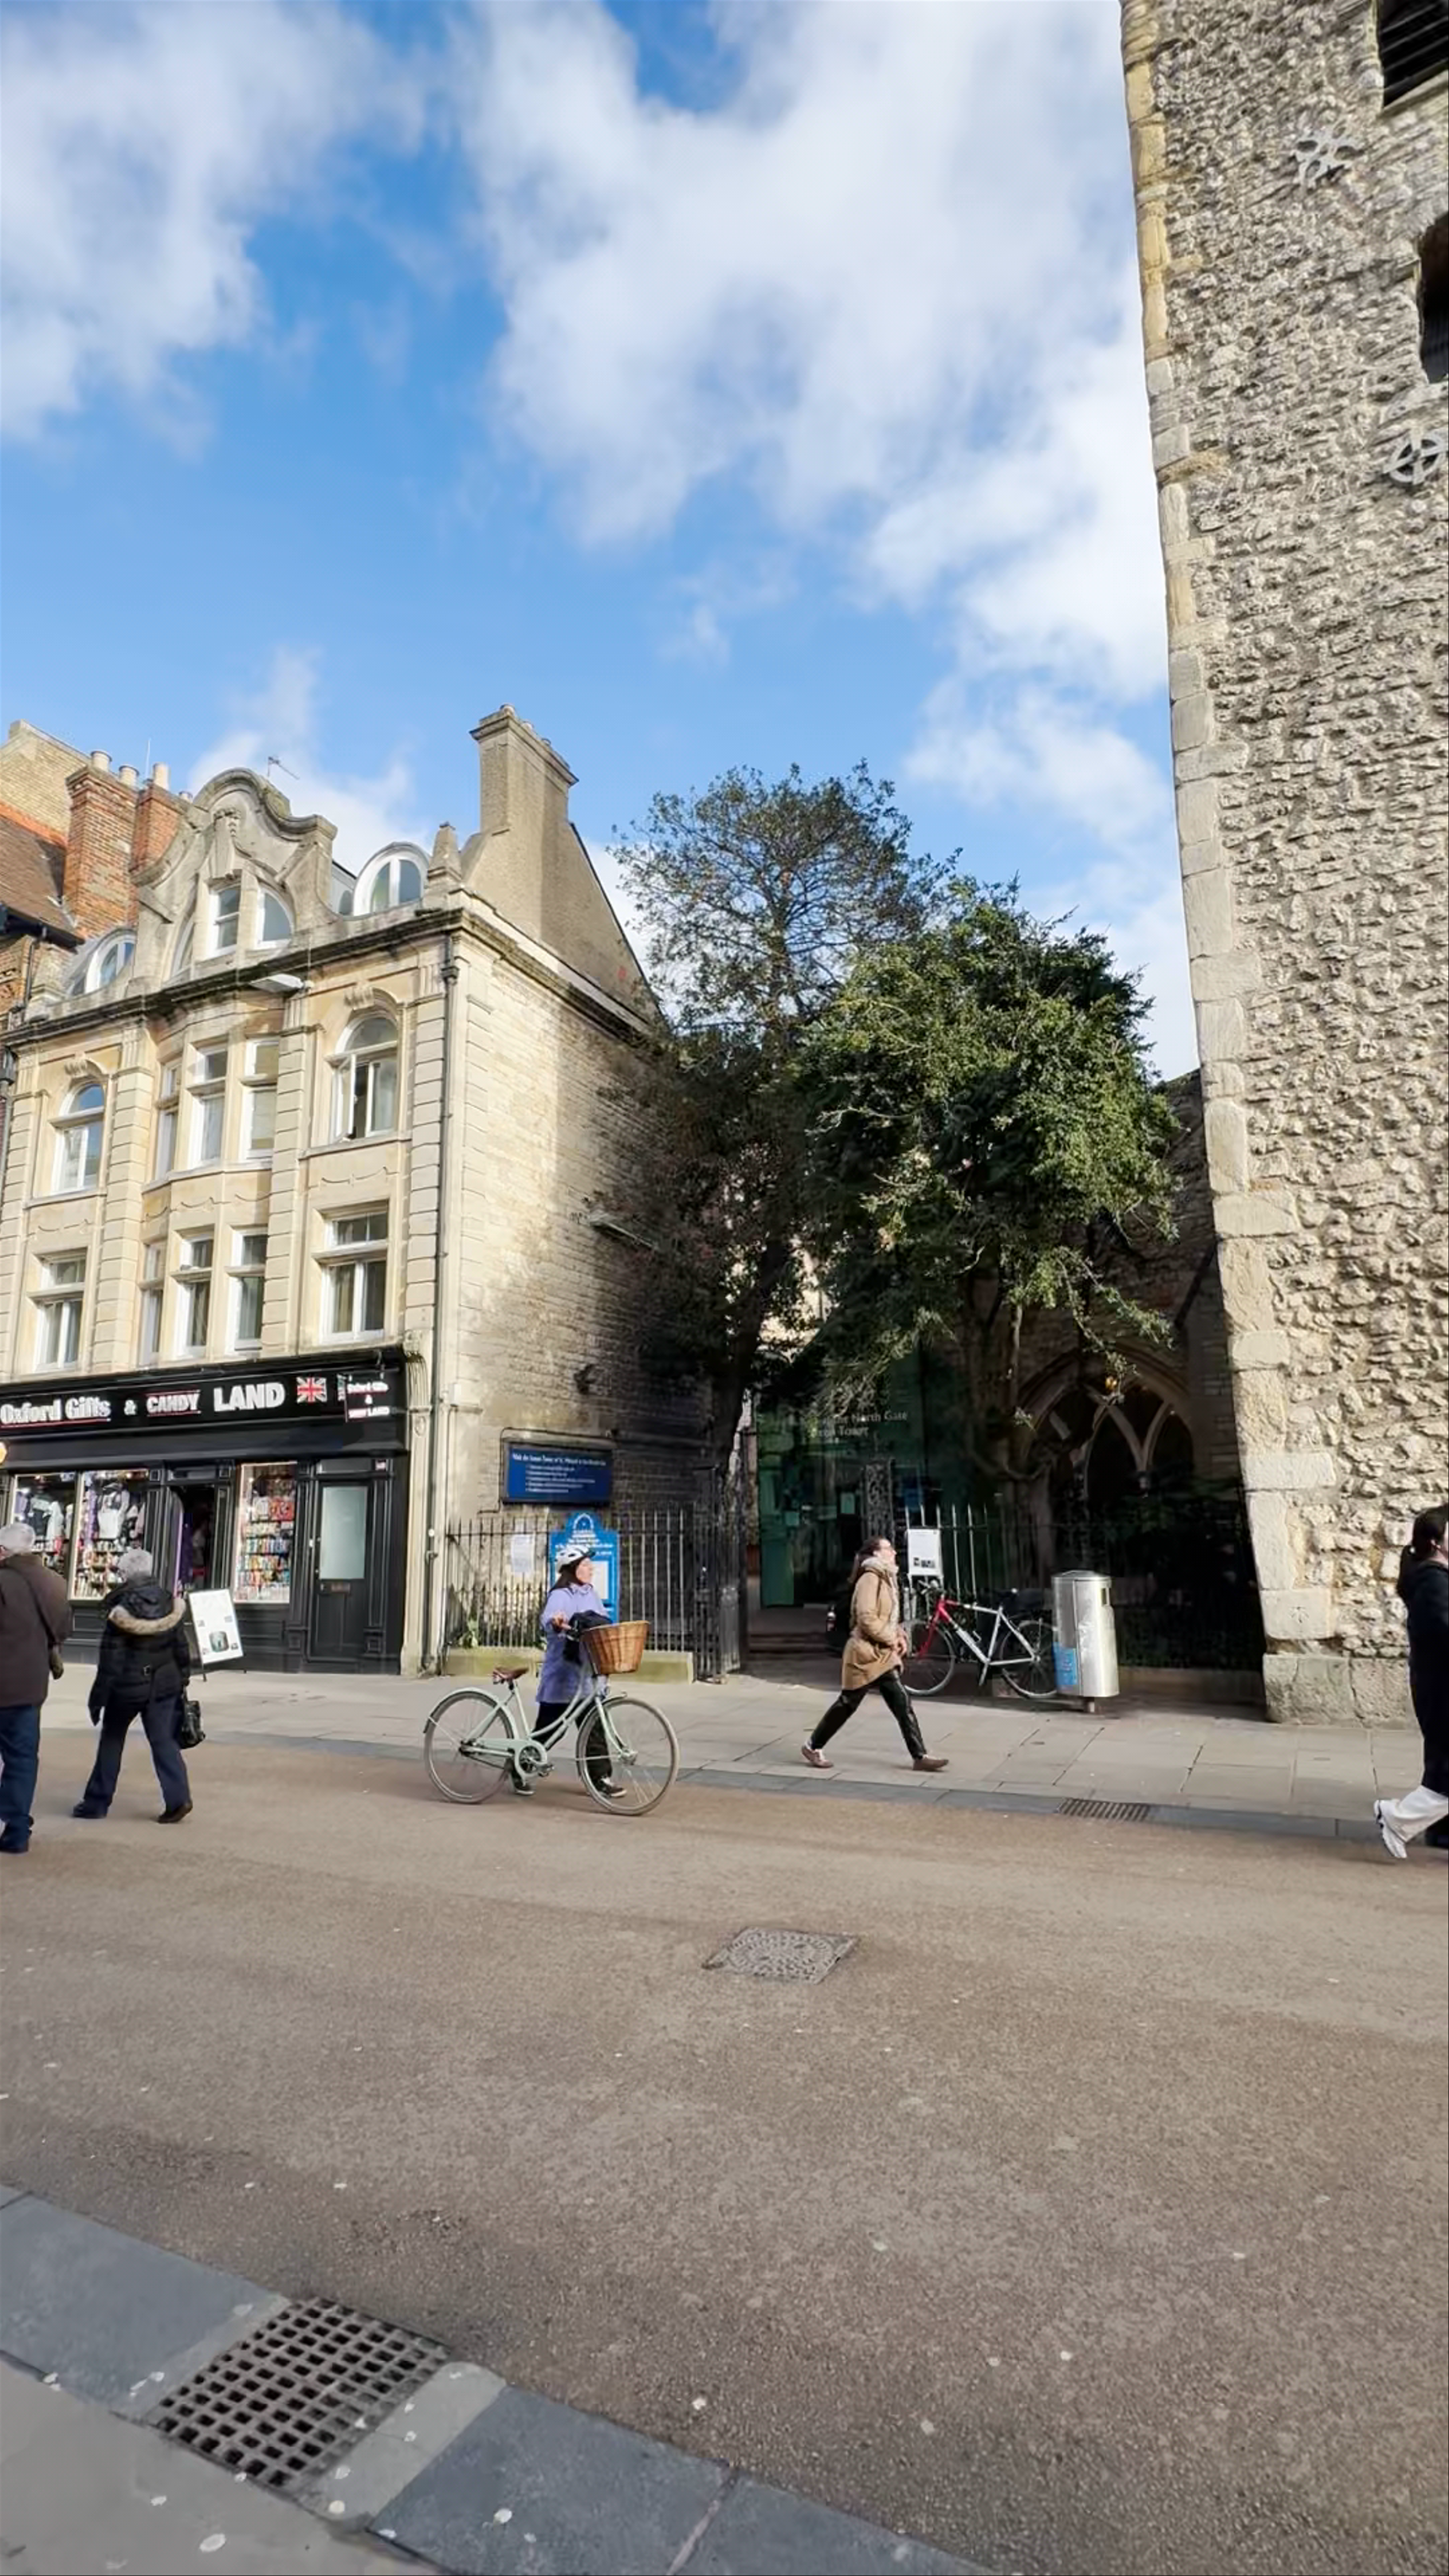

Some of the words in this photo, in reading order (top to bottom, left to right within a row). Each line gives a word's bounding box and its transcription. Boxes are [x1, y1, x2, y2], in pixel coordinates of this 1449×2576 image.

[0, 1399, 62, 1424] Oxford
[65, 1396, 111, 1420] Gifts
[124, 1399, 137, 1415] &
[146, 1393, 200, 1413] CANDY
[214, 1382, 285, 1412] LAND
